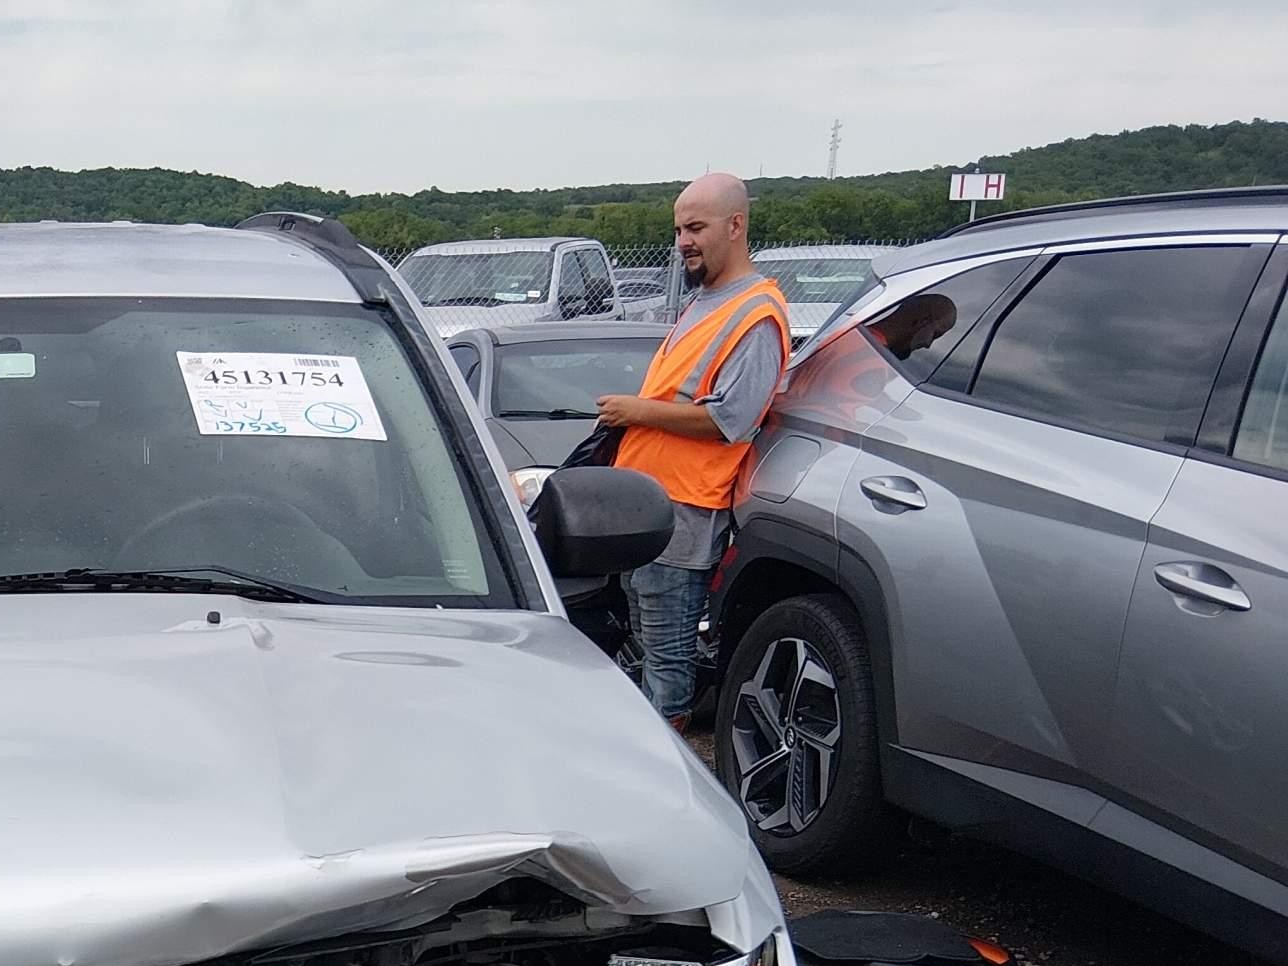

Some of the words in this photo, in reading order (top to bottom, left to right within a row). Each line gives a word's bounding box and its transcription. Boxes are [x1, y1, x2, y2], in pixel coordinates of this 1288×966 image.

[984, 175, 1002, 199] H
[203, 370, 344, 387] 45131754
[215, 420, 287, 434] 137525
